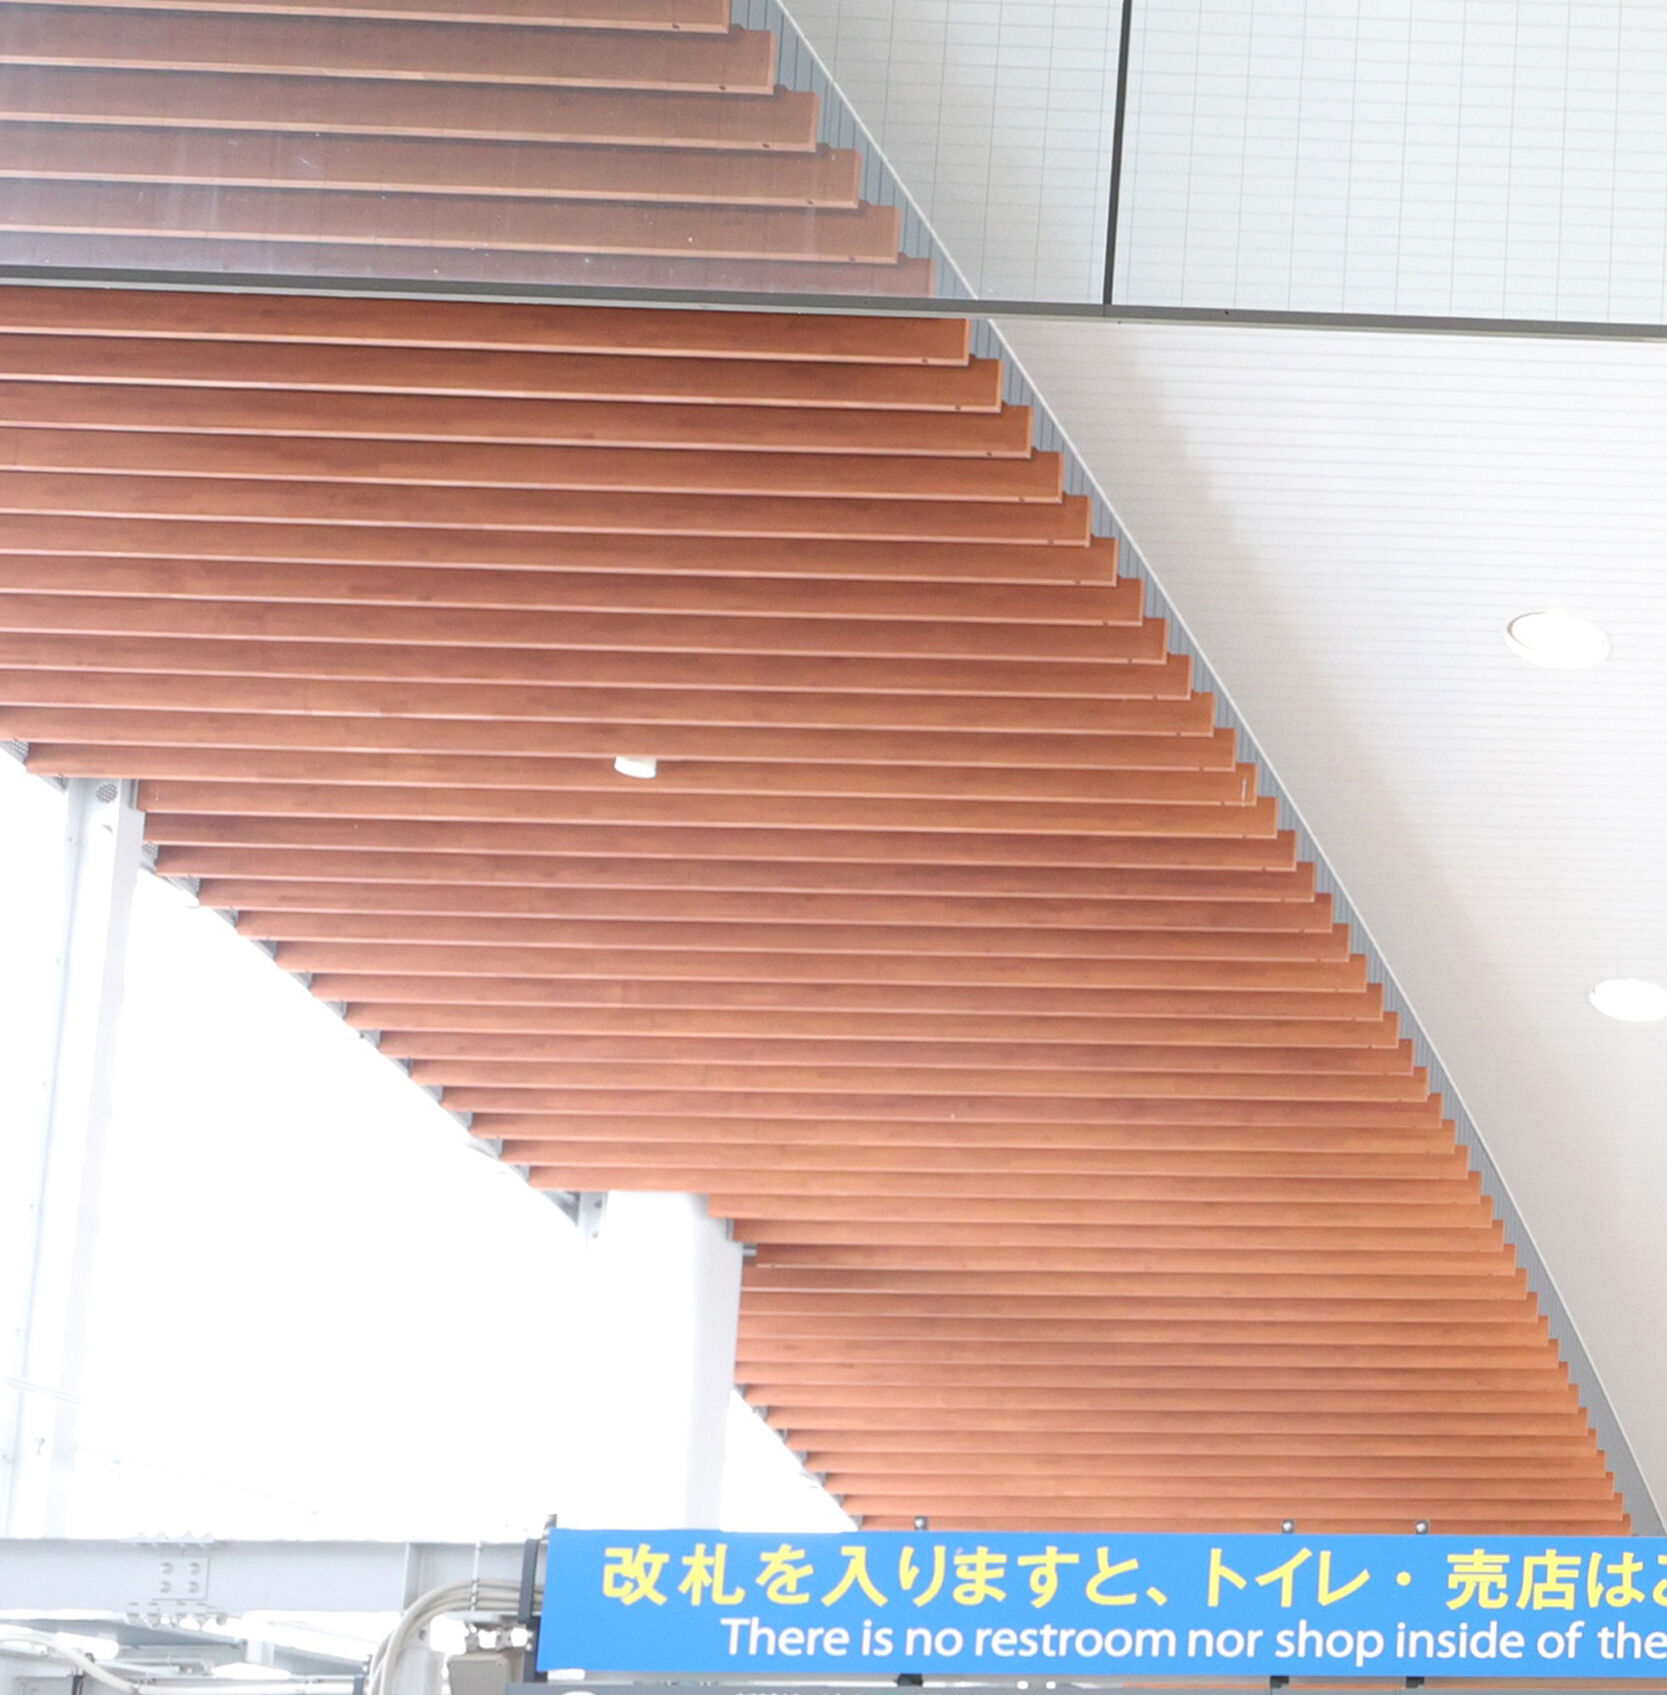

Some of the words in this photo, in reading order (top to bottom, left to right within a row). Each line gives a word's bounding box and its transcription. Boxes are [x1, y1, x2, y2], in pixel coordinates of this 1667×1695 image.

[720, 1617, 849, 1657] There
[862, 1618, 894, 1657] is
[907, 1629, 962, 1657] no
[975, 1623, 1176, 1658] restroom
[1187, 1630, 1263, 1658] nor
[1274, 1620, 1384, 1668] shop
[1396, 1620, 1525, 1659] inside
[1539, 1620, 1585, 1659] of
[1597, 1620, 1667, 1659] the
